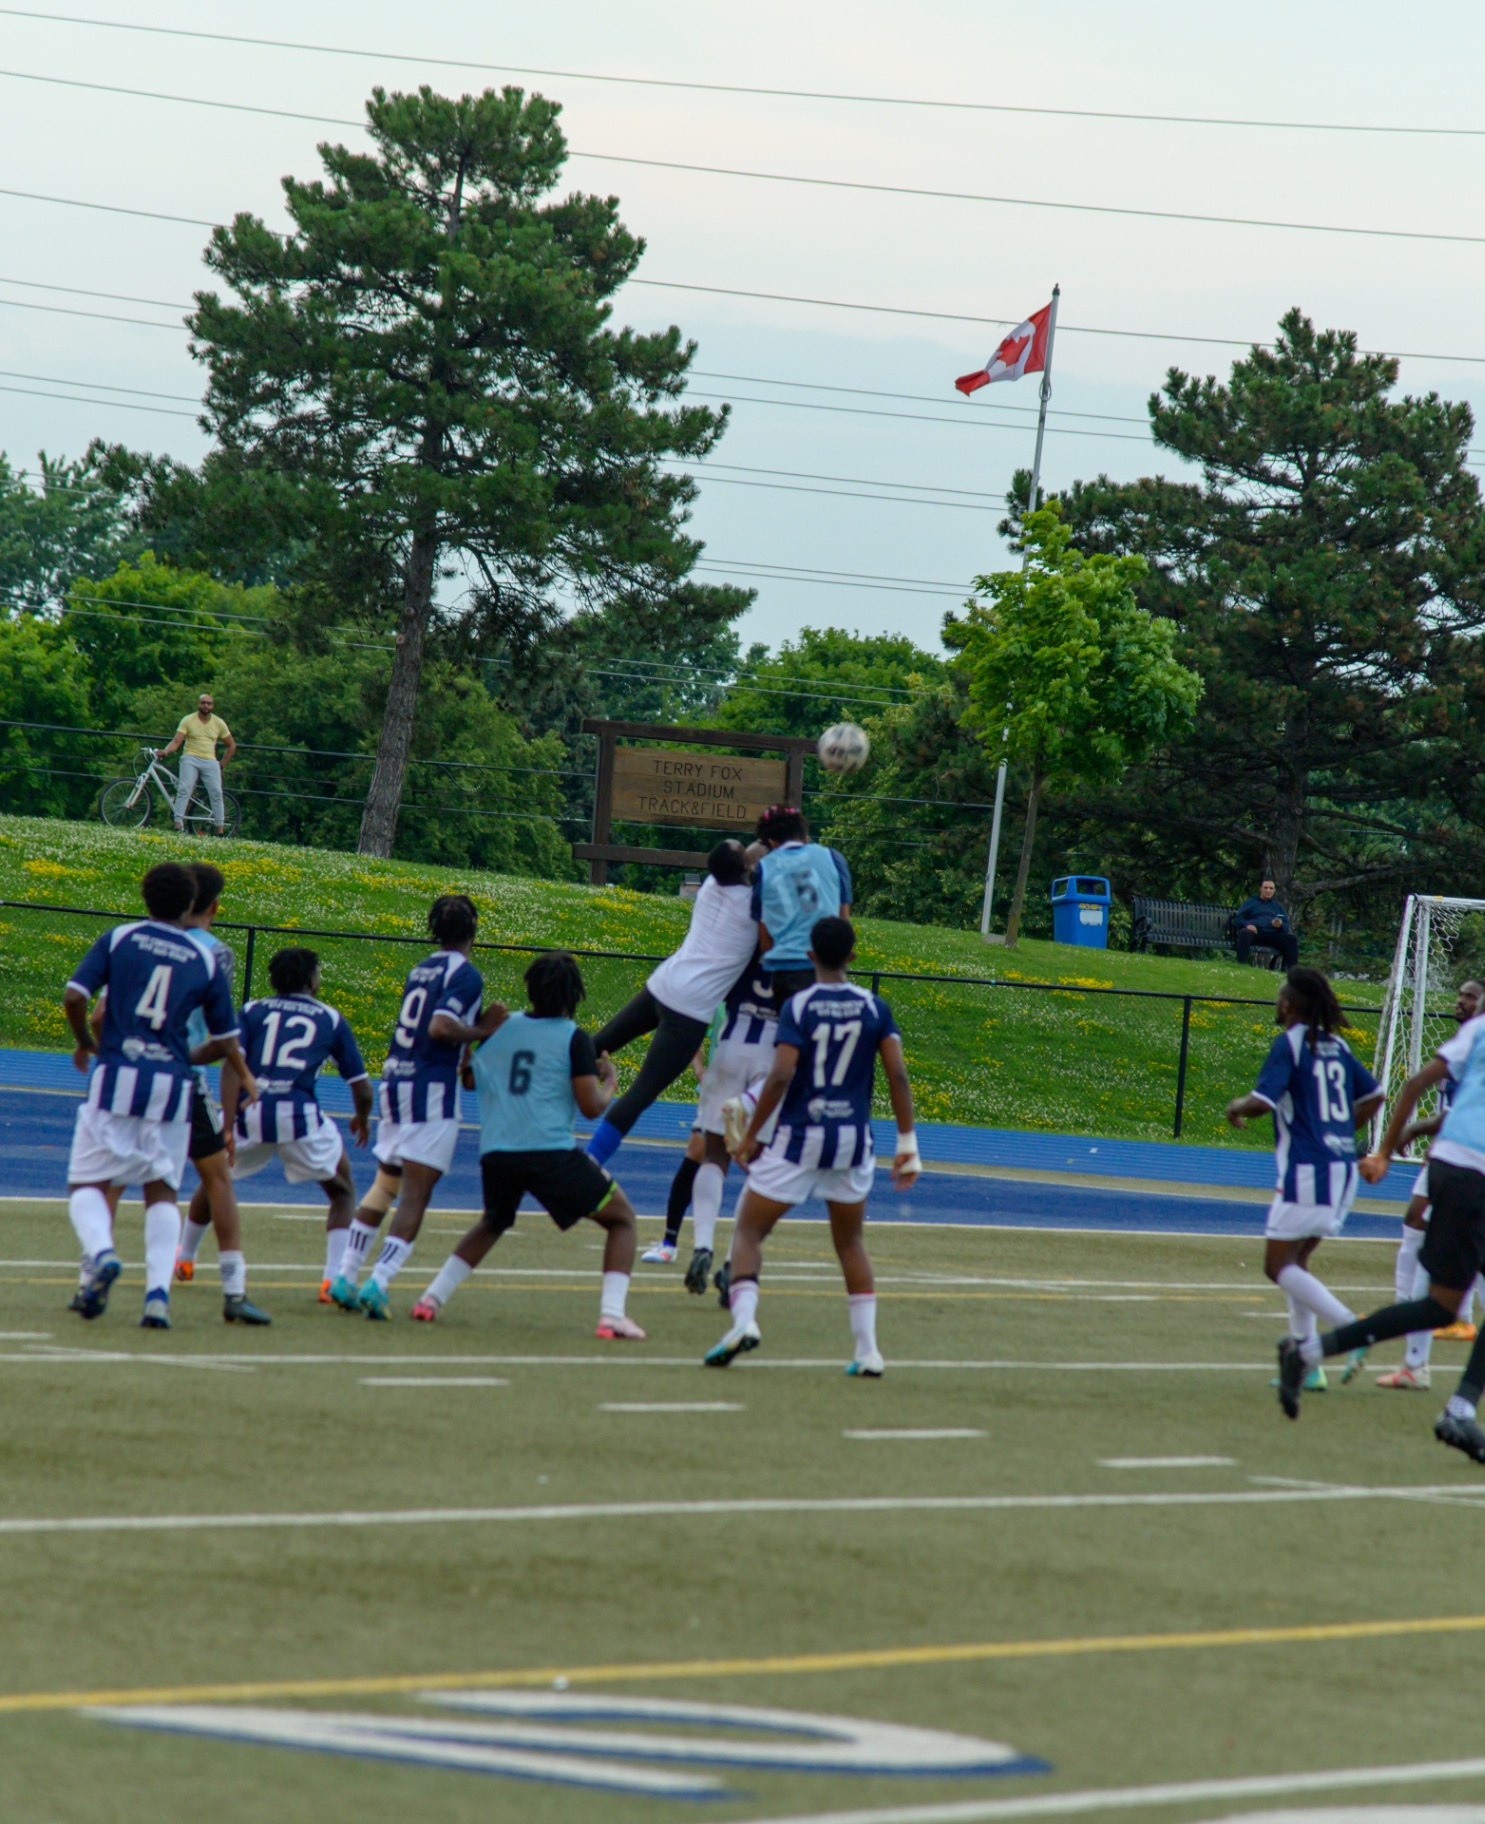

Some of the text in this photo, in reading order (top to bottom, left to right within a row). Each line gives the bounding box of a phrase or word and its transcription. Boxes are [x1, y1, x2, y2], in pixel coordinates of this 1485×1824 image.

[653, 759, 743, 782] TERRY FOX
[663, 780, 735, 799] STADIUM
[135, 965, 172, 1031] 4
[395, 987, 428, 1048] 9
[260, 1011, 317, 1070] 12
[812, 1020, 863, 1088] 17
[508, 1049, 536, 1096] 6
[1312, 1059, 1350, 1123] 13
